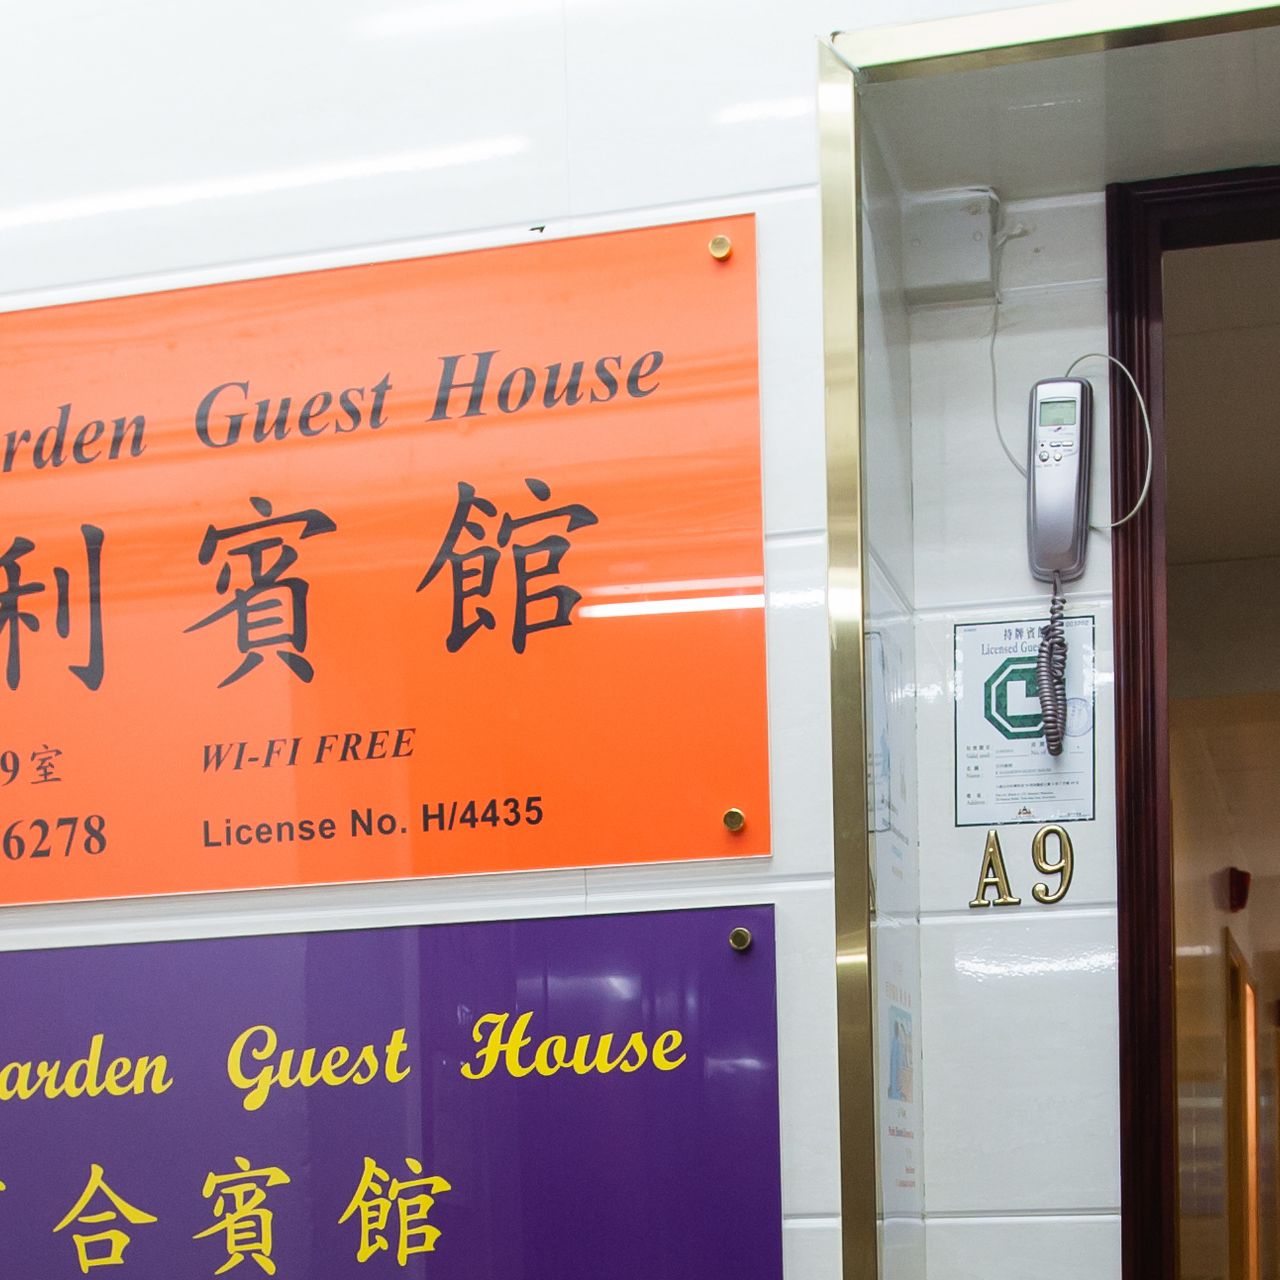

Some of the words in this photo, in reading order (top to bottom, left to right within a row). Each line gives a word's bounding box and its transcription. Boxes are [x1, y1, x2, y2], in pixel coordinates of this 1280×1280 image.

[195, 374, 393, 448] Guest
[425, 350, 664, 421] House
[981, 642, 1018, 655] Licensed
[203, 737, 301, 771] WI-FI
[315, 728, 413, 764] FREE
[2, 815, 107, 860] 6278
[203, 818, 336, 848] License
[350, 807, 407, 837] No.
[422, 796, 544, 833] H/4435
[228, 1026, 411, 1112] Guest
[460, 1011, 687, 1080] House
